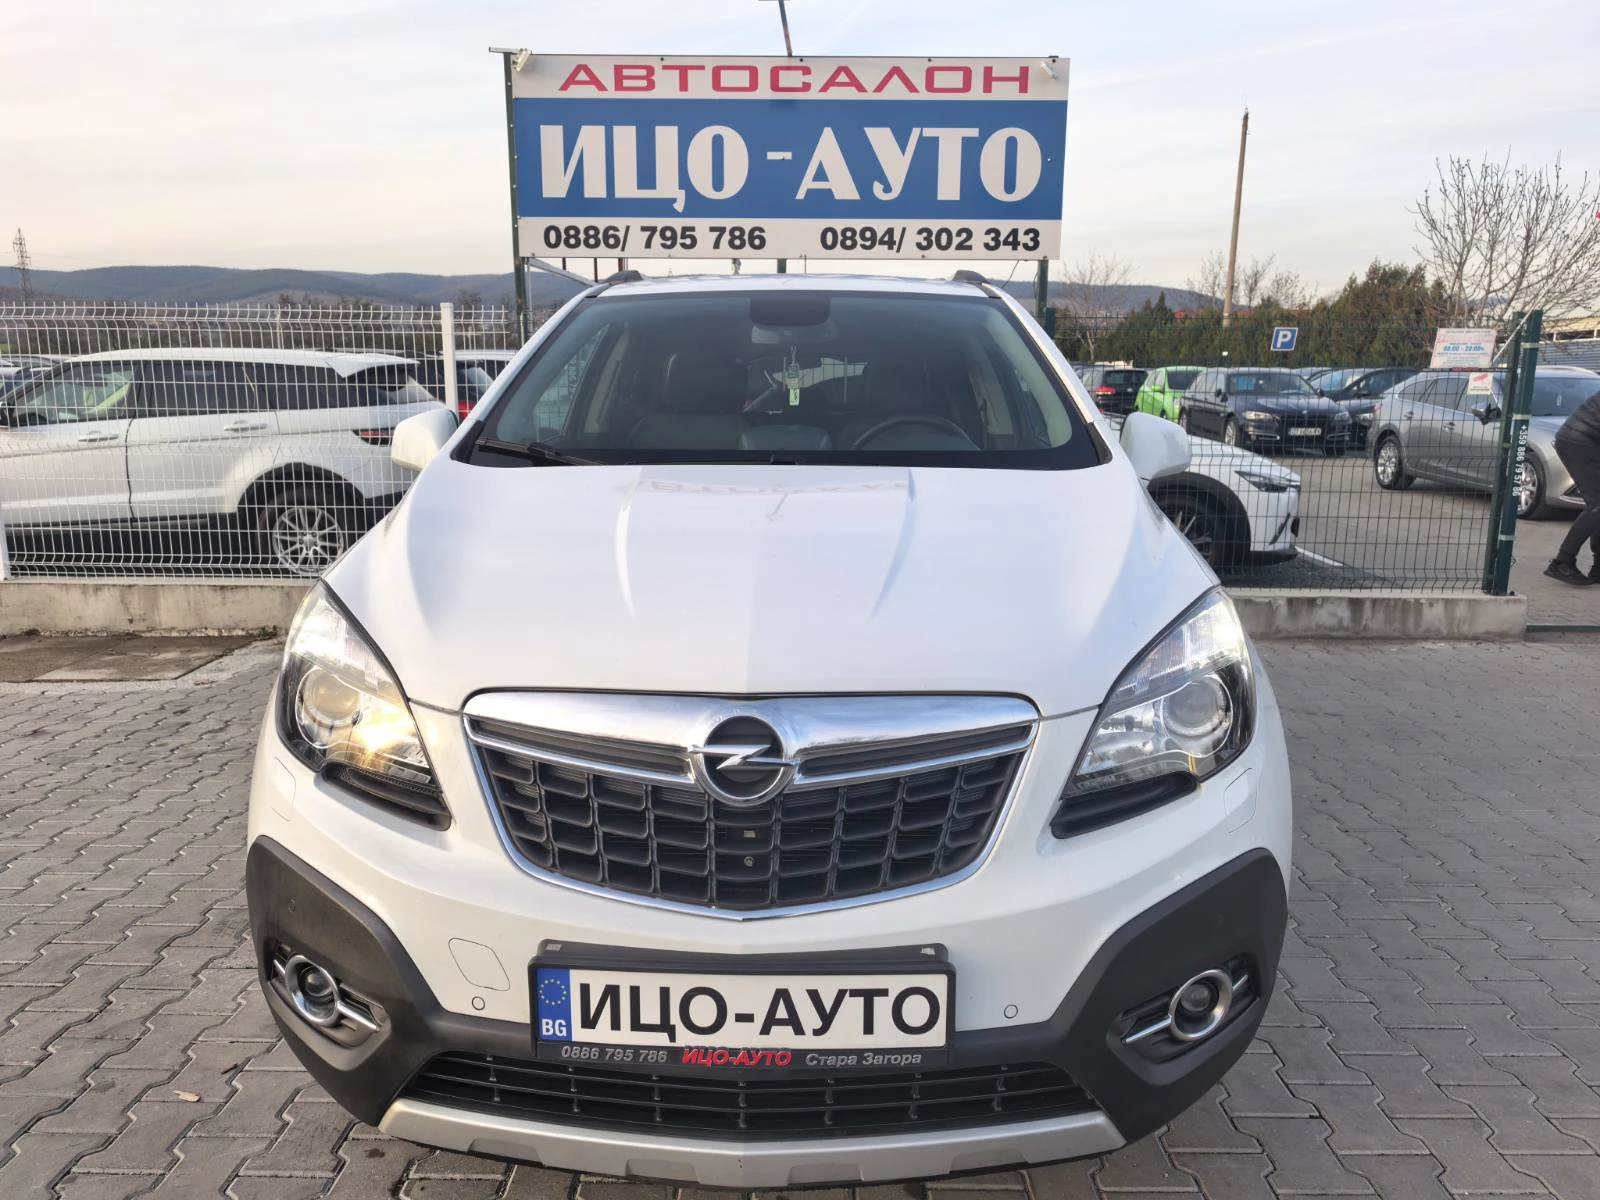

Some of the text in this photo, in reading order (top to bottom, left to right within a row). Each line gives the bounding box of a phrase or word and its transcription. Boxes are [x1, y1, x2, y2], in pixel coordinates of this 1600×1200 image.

[558, 63, 1030, 94] АВТОСАЛОН
[543, 224, 767, 252] 0886/ 795 786
[819, 226, 1041, 253] 0894/ 302 343
[1276, 330, 1292, 348] P
[579, 982, 941, 1043] ИЦО-АУТО
[541, 1018, 568, 1038] BG
[561, 1045, 668, 1063] 0886 795 786
[681, 1047, 793, 1067] ИЦО-АУТО
[805, 1052, 922, 1067] Стара Загора
